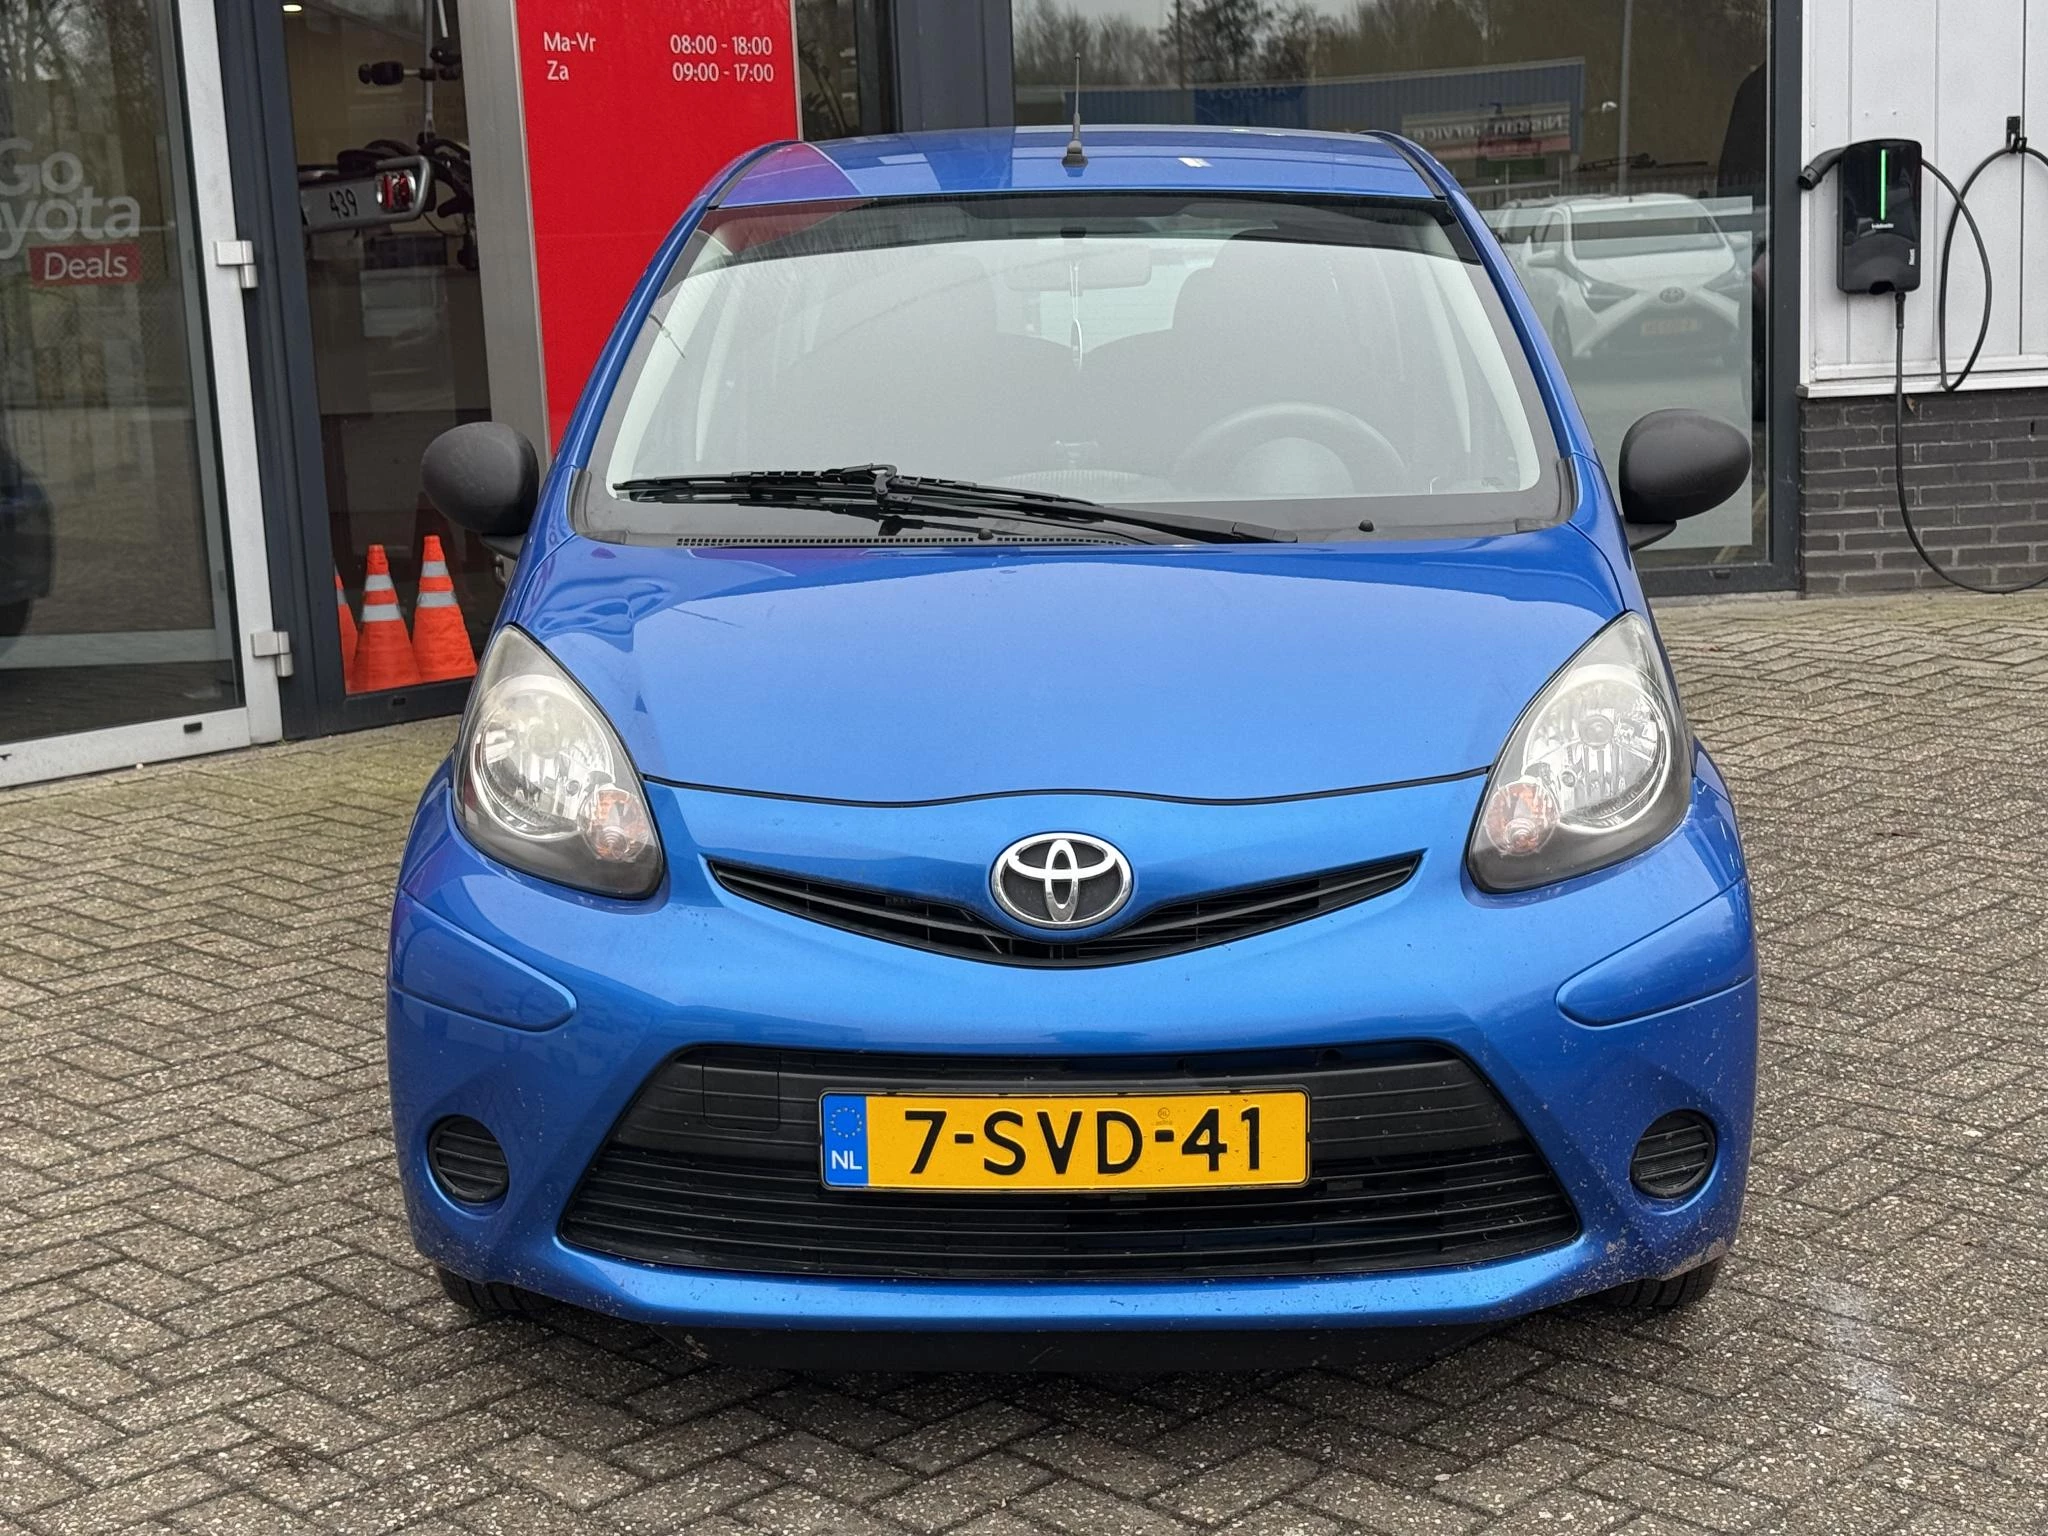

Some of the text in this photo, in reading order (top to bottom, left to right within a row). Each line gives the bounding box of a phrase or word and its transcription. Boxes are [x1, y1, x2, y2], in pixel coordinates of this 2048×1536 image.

[543, 32, 597, 53] Ma-Vr
[670, 34, 718, 54] 08:00
[731, 36, 773, 56] 18:00
[546, 60, 570, 81] Za
[672, 62, 719, 82] 09:00
[733, 63, 775, 83] 17:00
[0, 136, 84, 196] Go
[329, 188, 358, 219] 439
[0, 186, 141, 260] yota
[44, 248, 128, 281] Deals
[904, 1106, 1260, 1176] 7-SVD-41
[831, 1150, 862, 1170] NL
